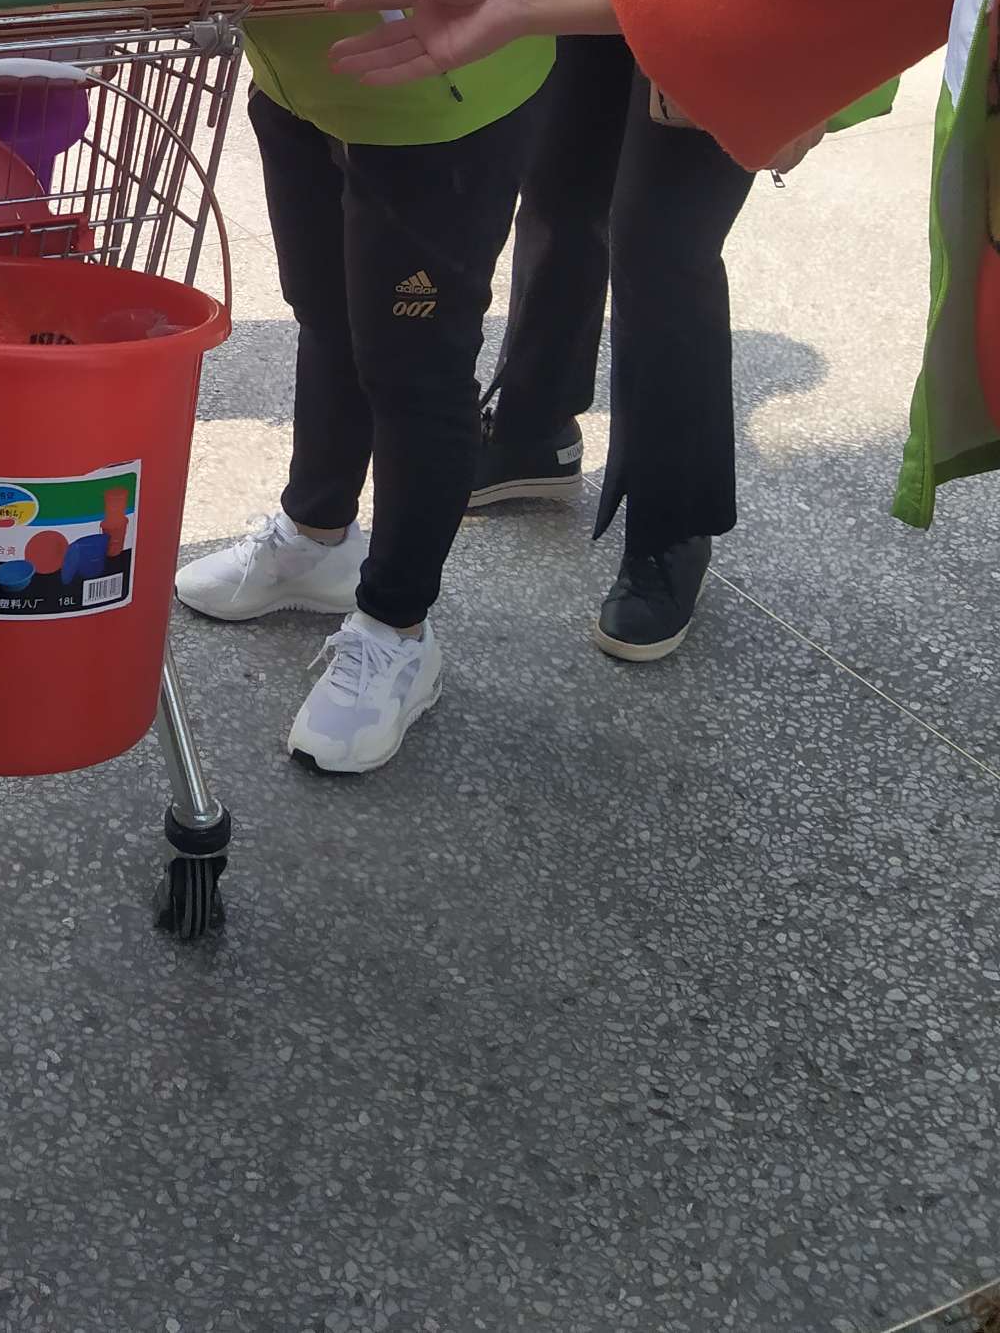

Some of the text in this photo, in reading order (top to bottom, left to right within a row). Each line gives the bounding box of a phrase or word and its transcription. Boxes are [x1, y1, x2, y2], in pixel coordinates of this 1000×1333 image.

[395, 284, 438, 295] adidas
[392, 301, 437, 318] 007
[57, 596, 77, 607] 18L
